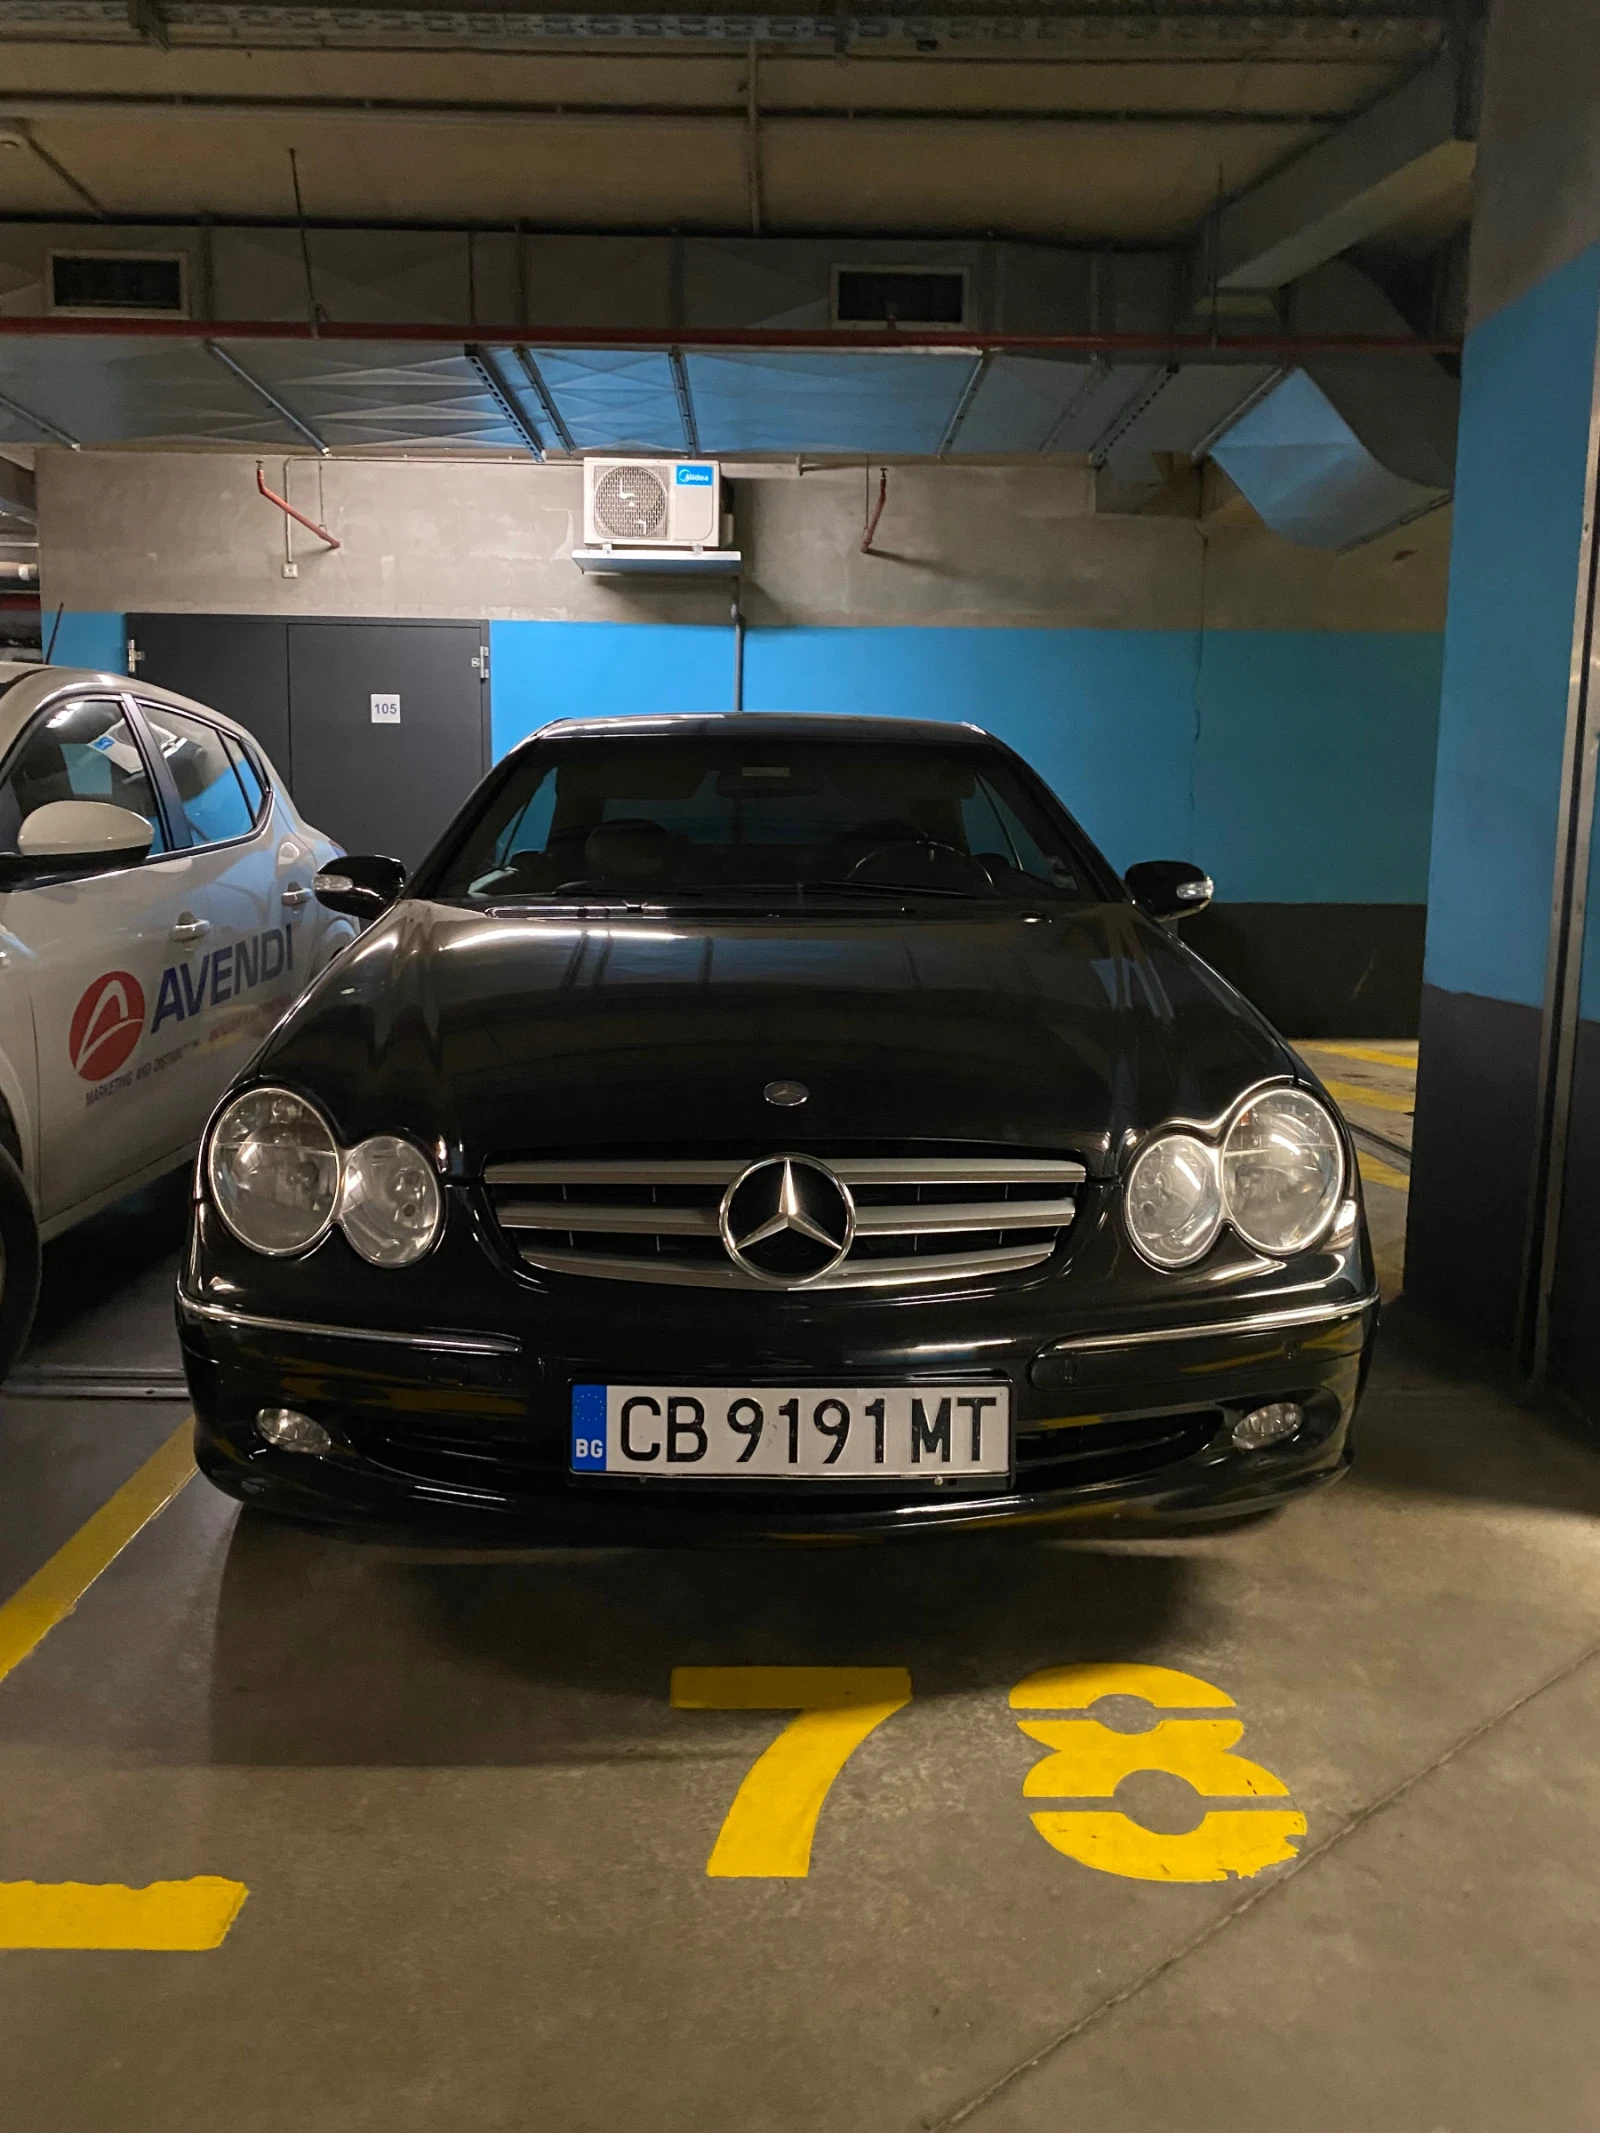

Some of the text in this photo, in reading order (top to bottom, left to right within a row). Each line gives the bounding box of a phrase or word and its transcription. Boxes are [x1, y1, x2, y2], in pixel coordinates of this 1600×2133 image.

[374, 703, 397, 715] 105
[150, 924, 294, 1034] AVENDI
[86, 1071, 133, 1107] MARKETING
[575, 1438, 603, 1458] BG
[620, 1396, 997, 1464] CB 9191 MT
